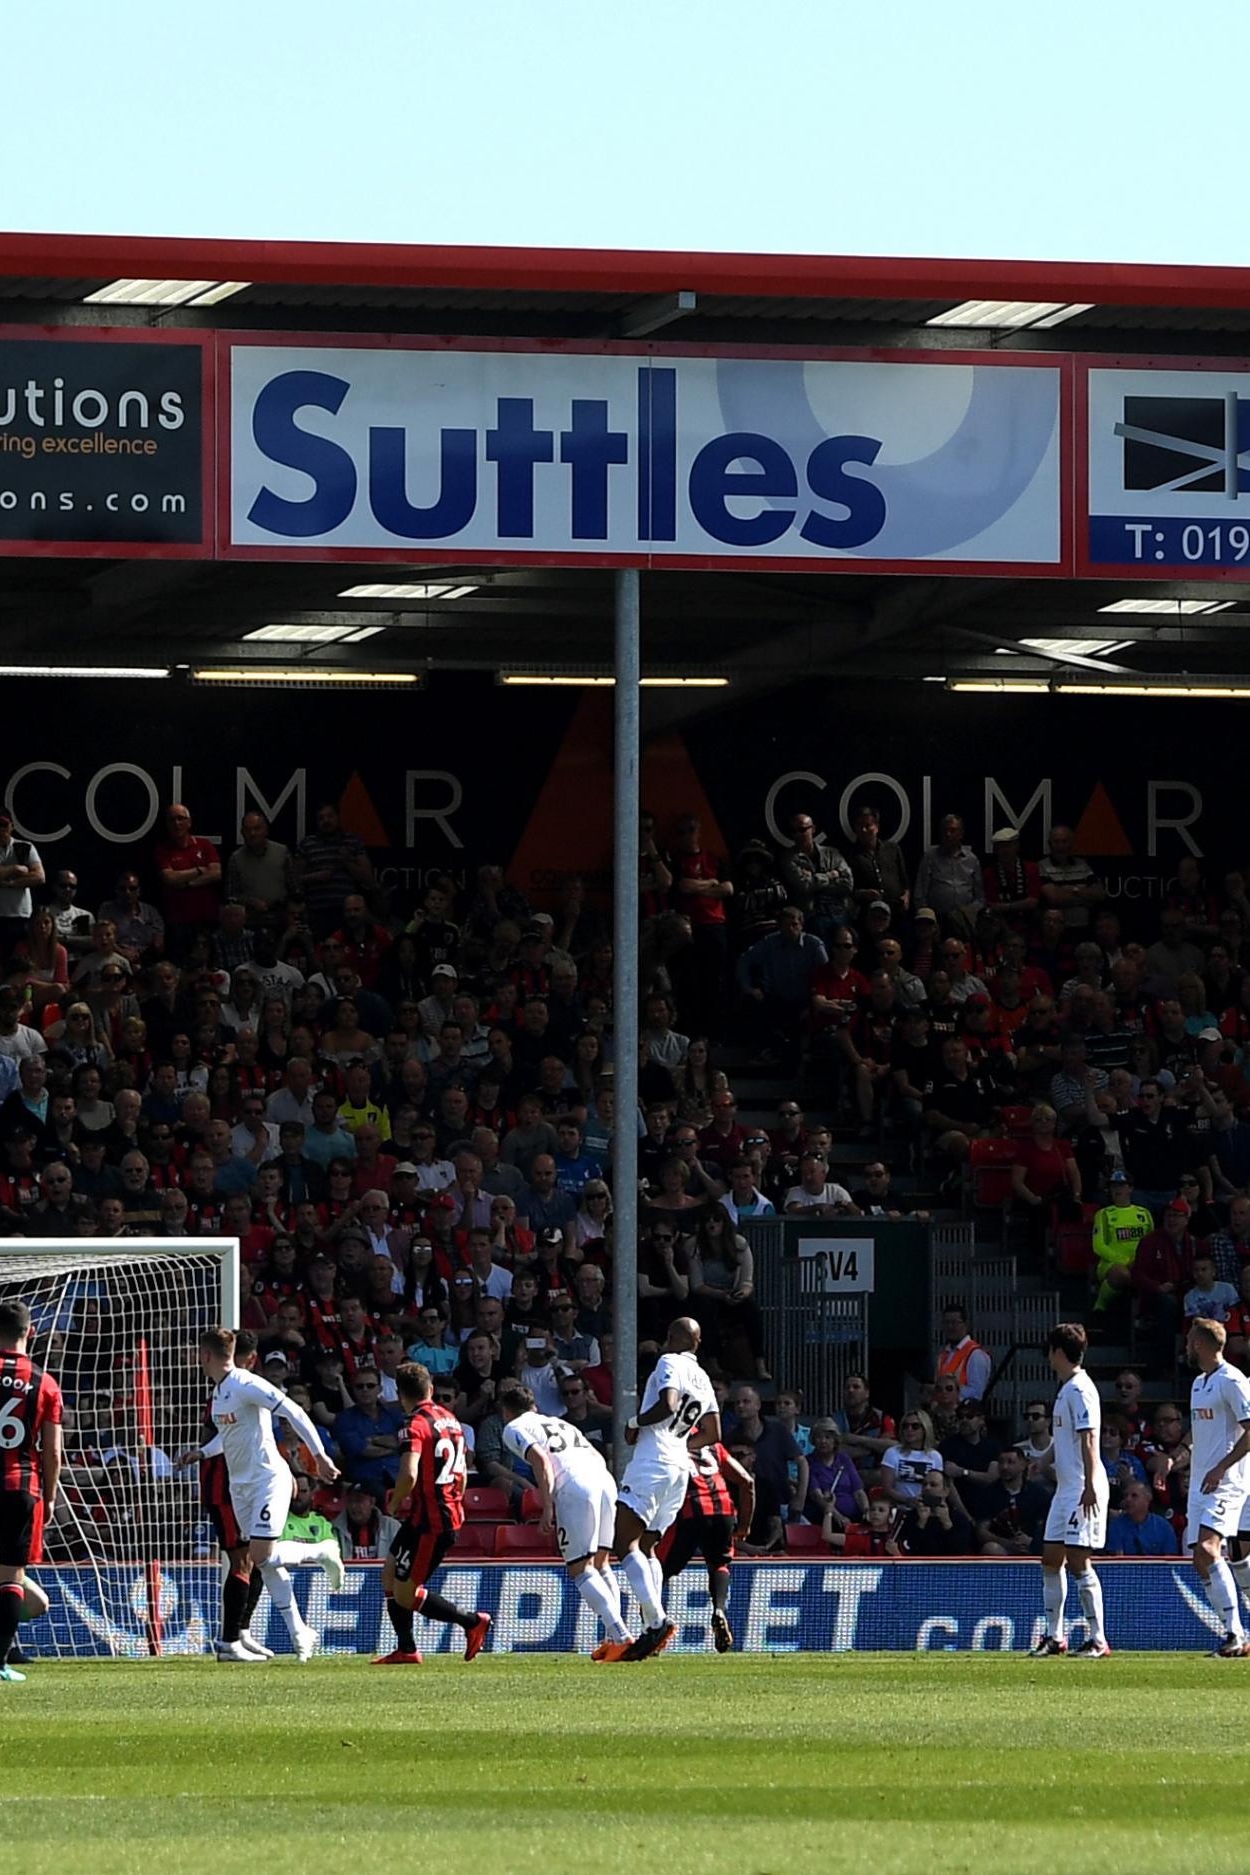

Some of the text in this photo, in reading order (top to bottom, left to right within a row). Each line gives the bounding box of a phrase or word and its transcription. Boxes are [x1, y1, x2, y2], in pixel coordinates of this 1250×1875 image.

[41, 434, 158, 455] excellence
[246, 367, 887, 549] Suttles
[1125, 524, 1165, 560] T:
[668, 1393, 702, 1438] 19
[541, 1423, 589, 1453] 52
[435, 1438, 466, 1485] 24
[260, 1503, 271, 1522] 6
[1068, 1510, 1079, 1529] 4
[1215, 1499, 1227, 1516] 5
